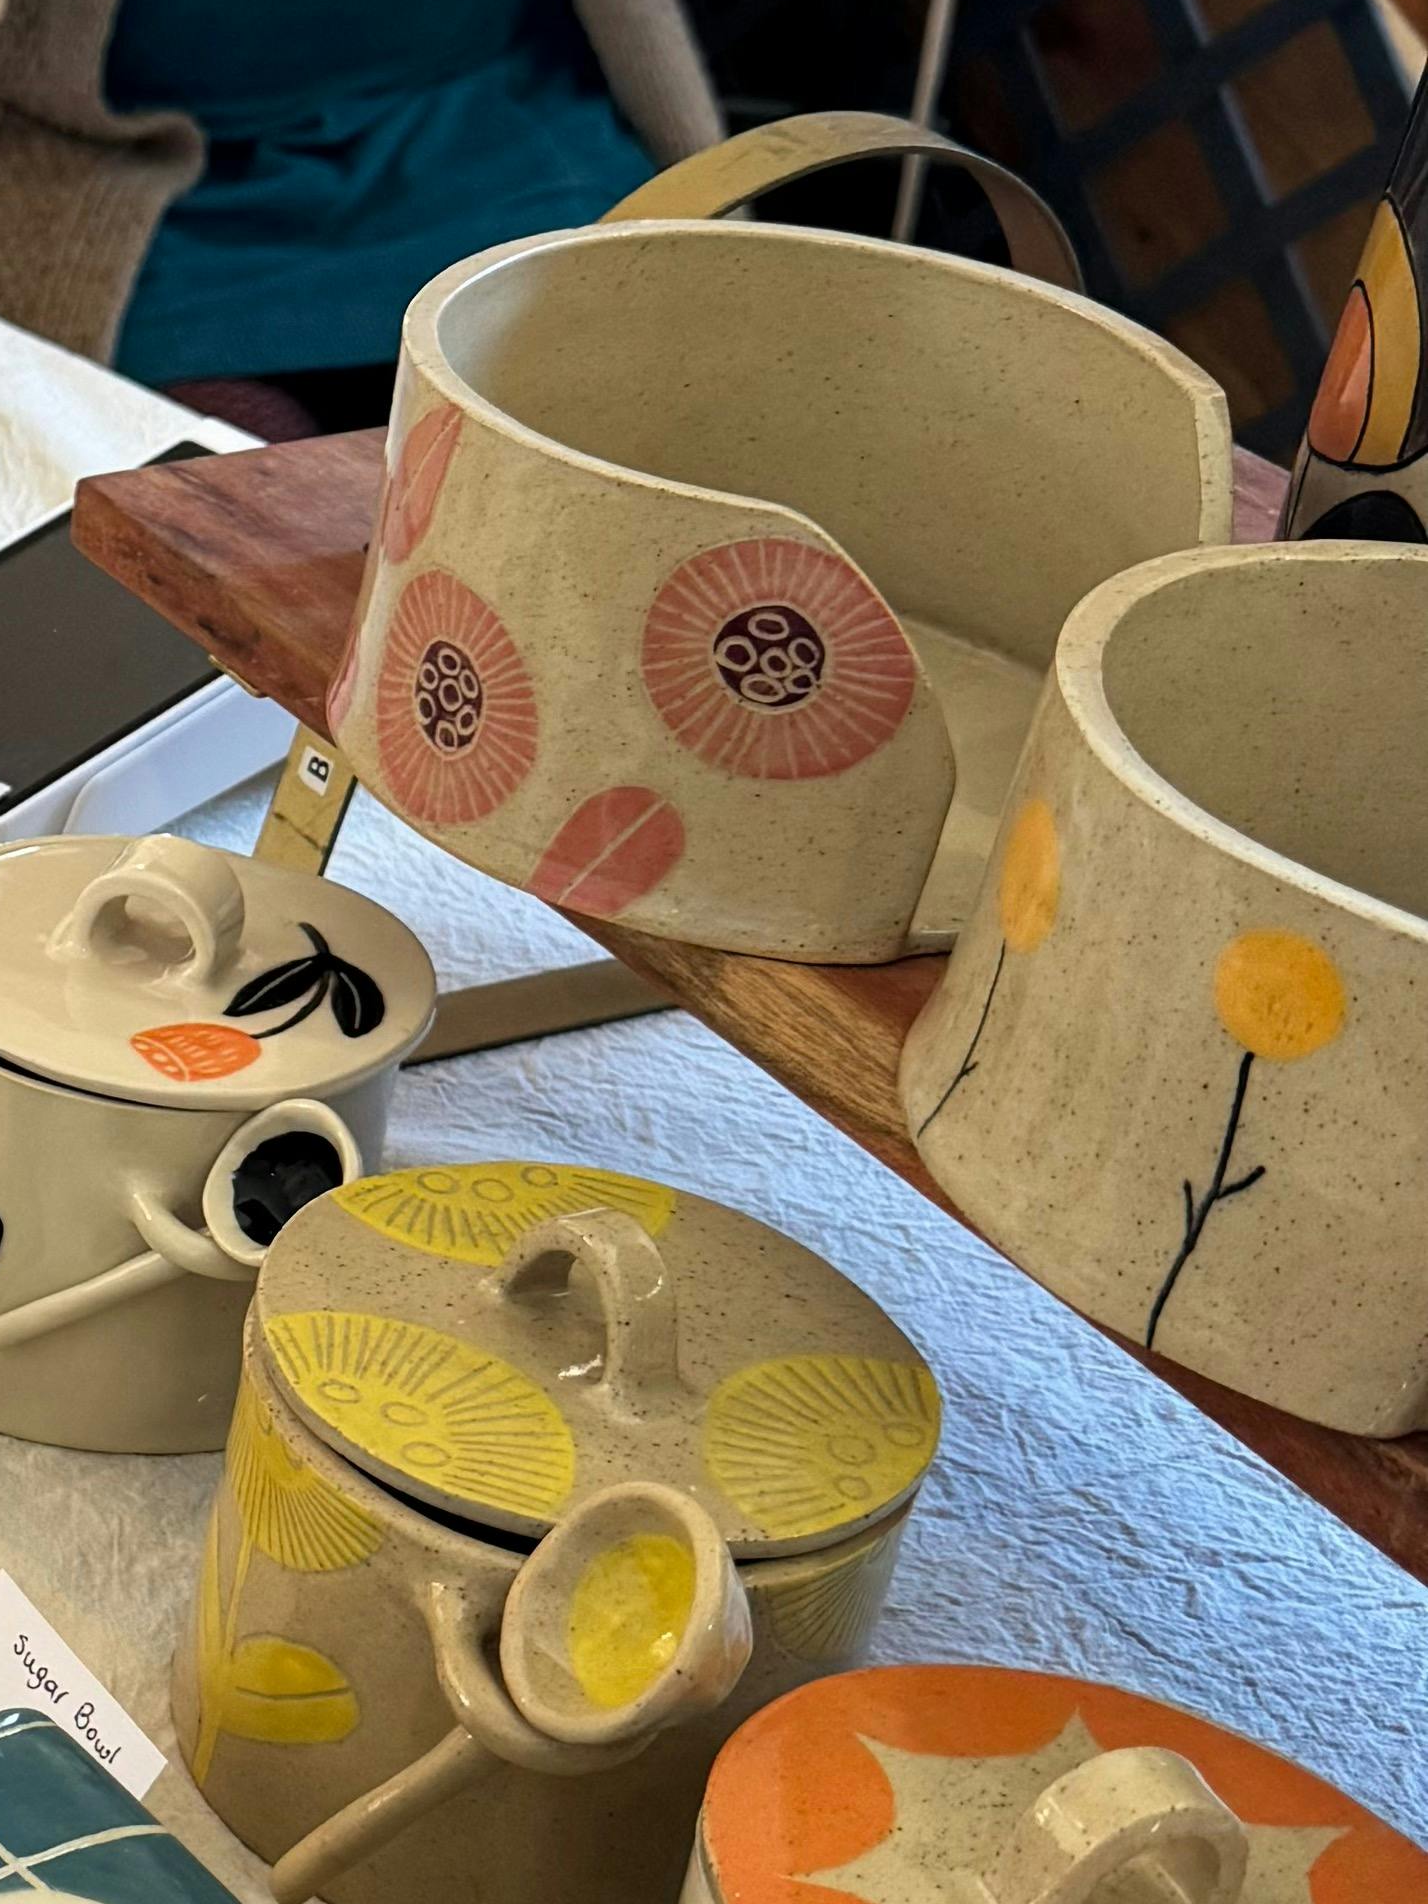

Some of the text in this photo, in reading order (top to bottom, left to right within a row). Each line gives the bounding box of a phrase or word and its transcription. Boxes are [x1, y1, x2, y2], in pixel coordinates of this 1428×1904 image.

[307, 756, 330, 783] B
[13, 1634, 122, 1765] Sugar Bowl
